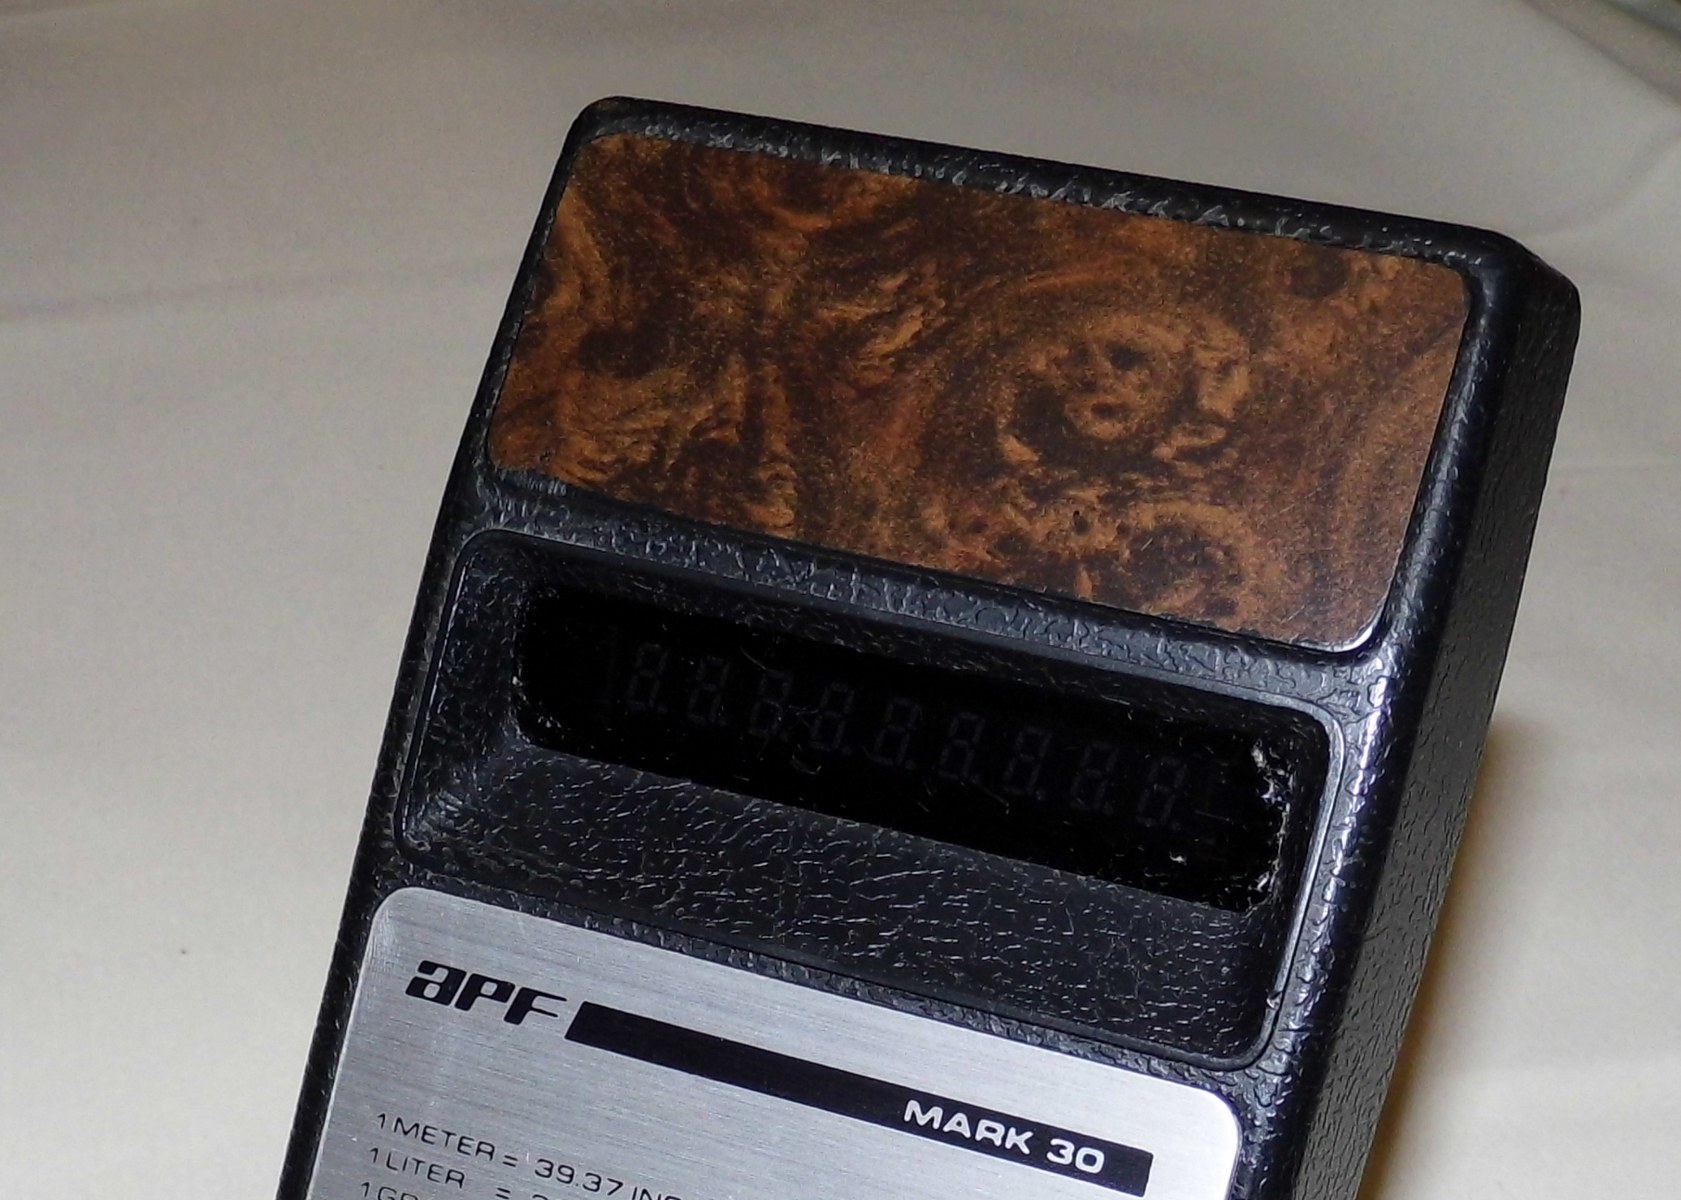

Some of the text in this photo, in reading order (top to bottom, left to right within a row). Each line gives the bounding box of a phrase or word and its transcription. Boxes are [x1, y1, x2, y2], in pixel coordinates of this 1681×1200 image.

[376, 1113, 387, 1129] 1
[393, 1117, 496, 1161] METER
[533, 1158, 624, 1196] 39.37
[903, 1099, 1106, 1174] MARK 30
[360, 1182, 370, 1198] 1
[369, 1147, 379, 1163] 1
[386, 1152, 466, 1189] LITER
